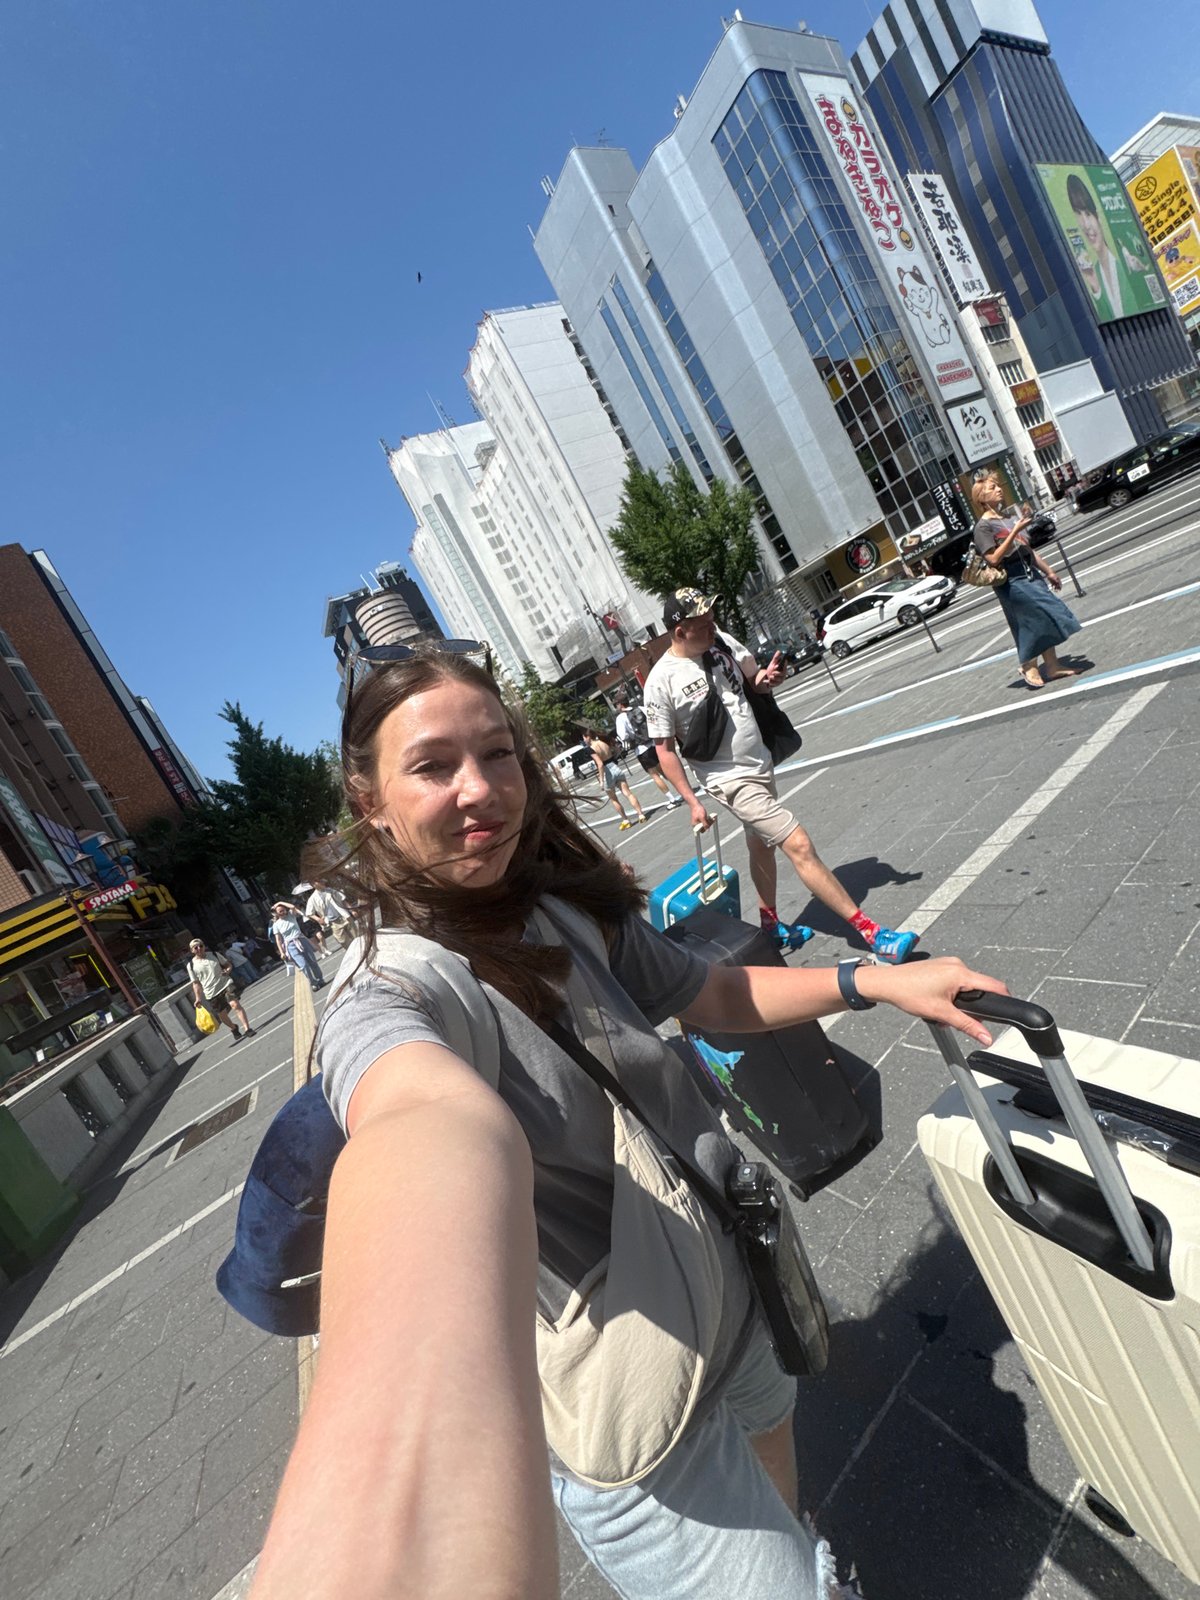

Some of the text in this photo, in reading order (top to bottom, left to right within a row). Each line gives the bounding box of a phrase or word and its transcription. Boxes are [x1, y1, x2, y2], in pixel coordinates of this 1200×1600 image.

[815, 94, 896, 251] まねきねこ
[1151, 180, 1180, 207] Single
[1142, 184, 1188, 227] キンキング」
[1149, 203, 1196, 249] lease!
[89, 883, 133, 909] SPOTAKA
